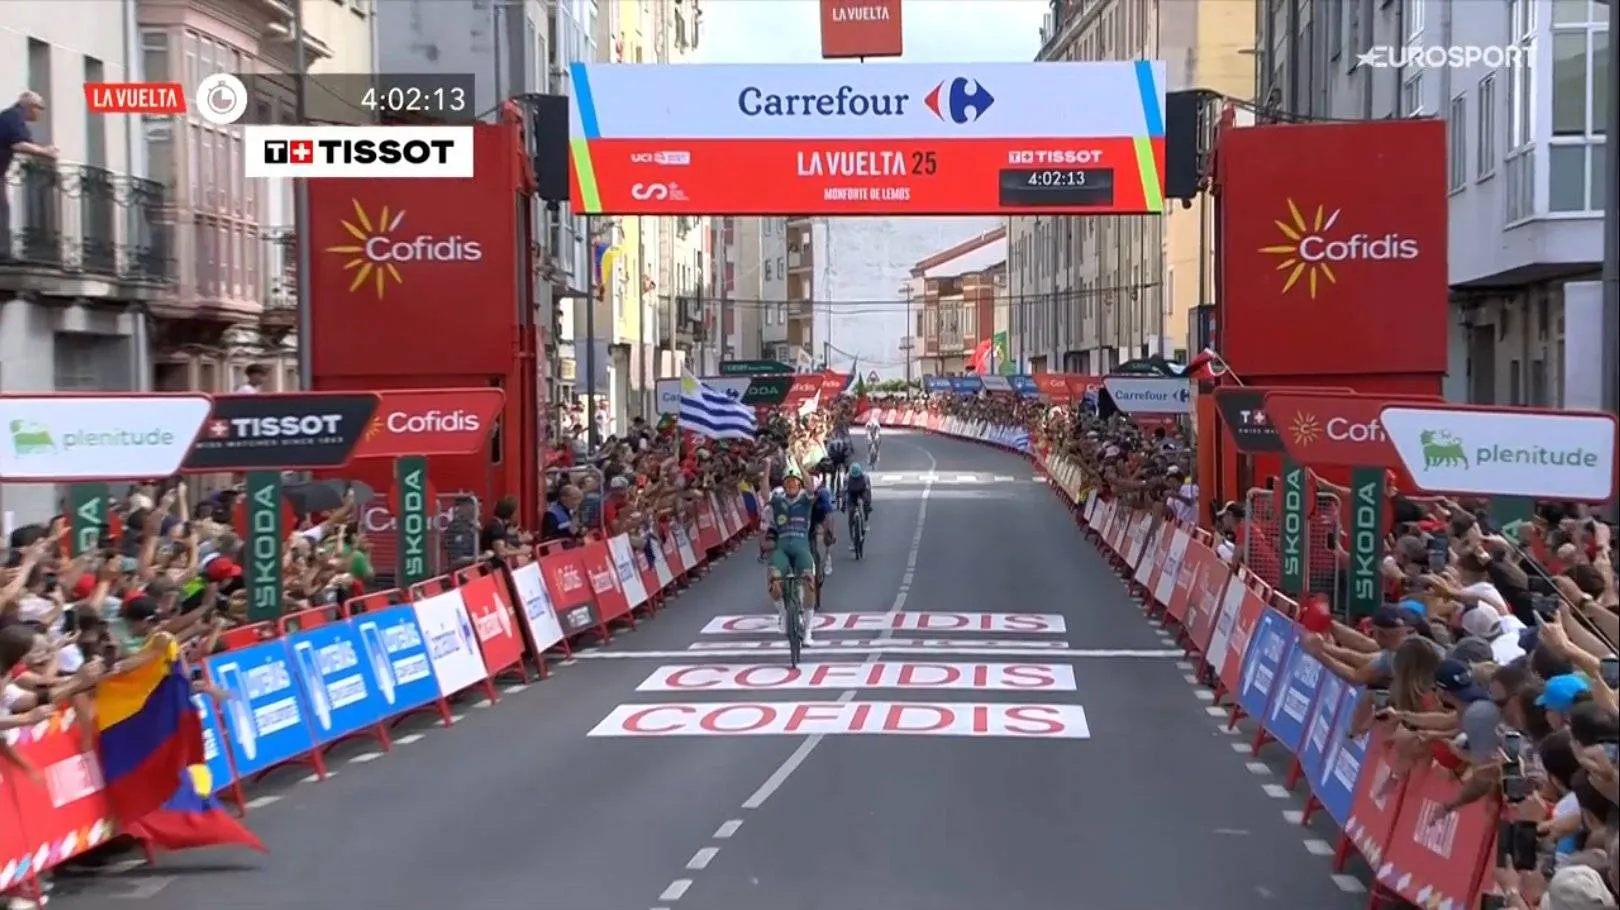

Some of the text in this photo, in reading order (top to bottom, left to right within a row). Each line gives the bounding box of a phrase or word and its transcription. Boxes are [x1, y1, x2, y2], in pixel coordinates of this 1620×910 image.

[832, 6, 889, 20] LA VUELTA
[737, 86, 909, 117] Carrefour
[797, 151, 937, 176] LA VUELTA 25
[1035, 150, 1103, 163] TISSOT
[1028, 171, 1085, 185] 4:02:13
[824, 187, 910, 200] MONFORTE DE LEMOS
[366, 235, 483, 262] Cofidis
[1299, 234, 1419, 262] Cofidis
[1114, 388, 1169, 402] Carrefour
[231, 414, 343, 438] TISSOT
[387, 408, 480, 436] Cofidis
[62, 427, 175, 450] plenitude
[1476, 443, 1599, 469] plenitude
[722, 613, 1049, 632] COFIDIS
[664, 663, 1056, 689] COFIDIS
[621, 704, 1066, 734] COFIDIS
